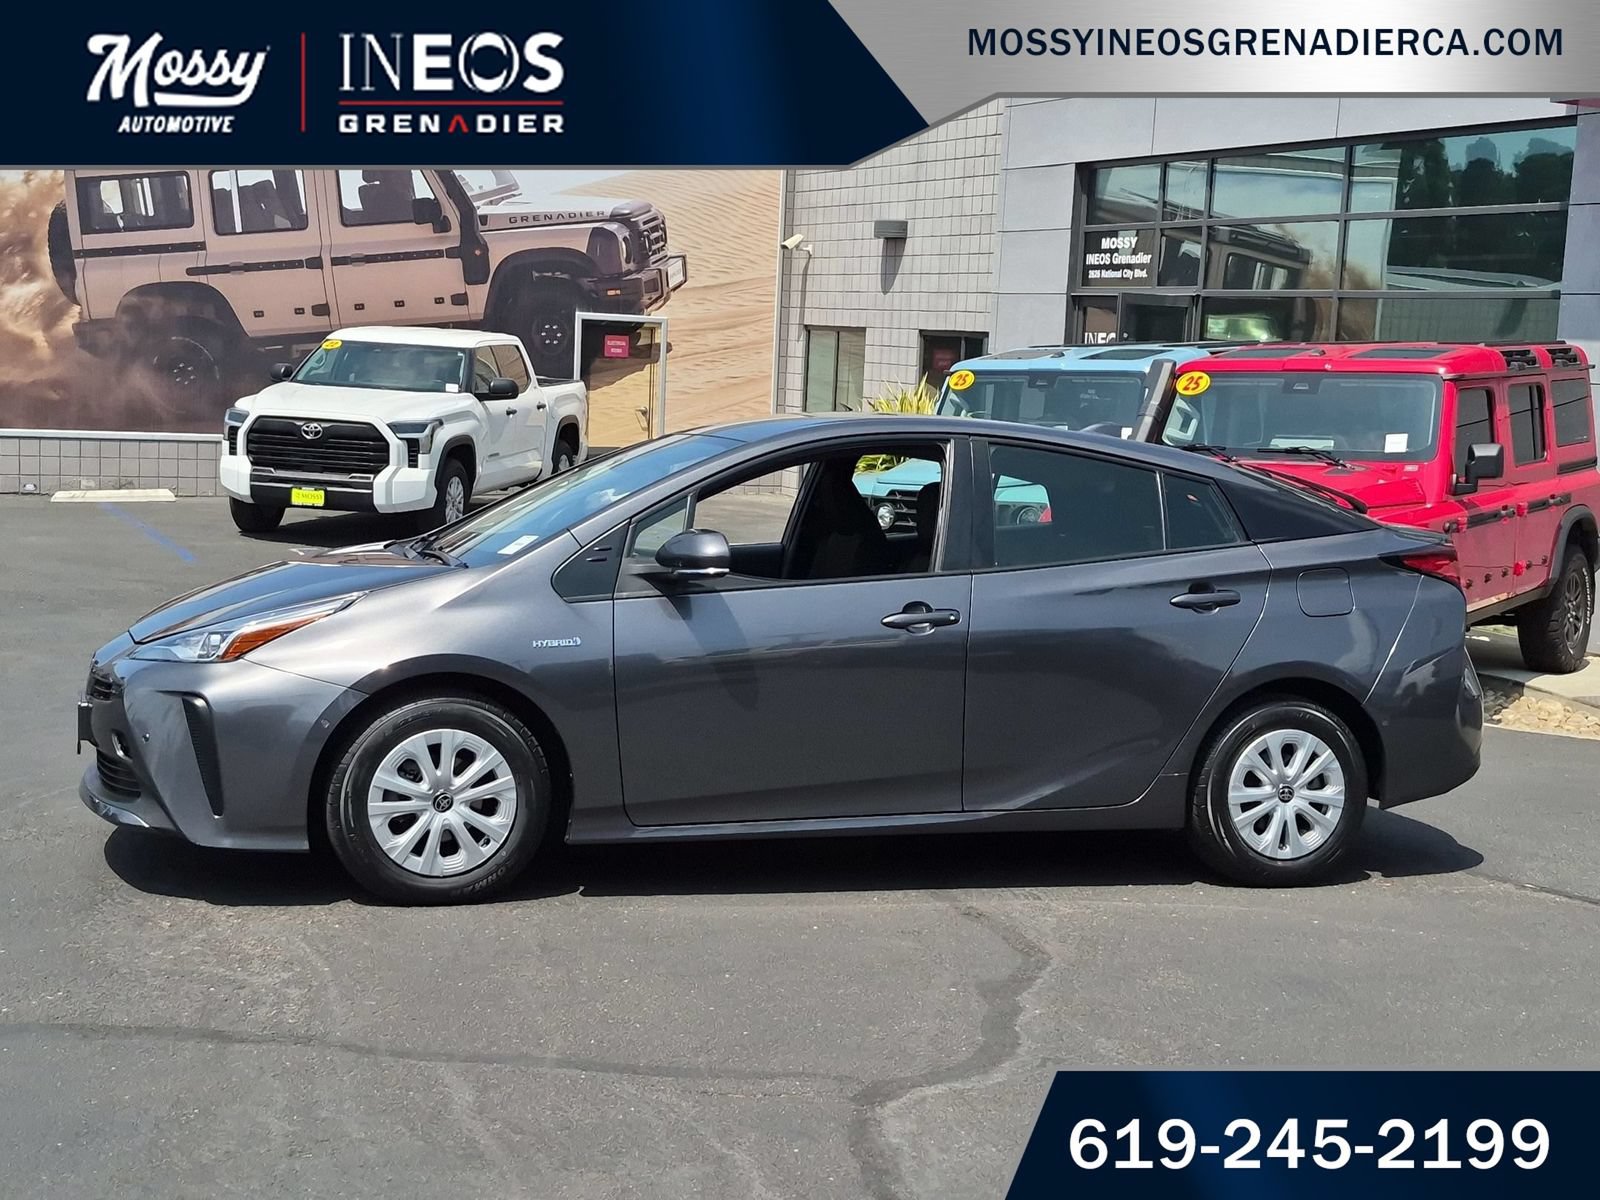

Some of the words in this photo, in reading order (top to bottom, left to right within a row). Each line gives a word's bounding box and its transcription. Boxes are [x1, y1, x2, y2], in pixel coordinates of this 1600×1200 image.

[509, 211, 605, 224] GRENADIER
[1101, 236, 1138, 250] MOSSY
[1086, 253, 1111, 265] INEOS
[1112, 252, 1152, 265] Grenadier
[1101, 269, 1122, 278] National
[1122, 268, 1133, 280] City
[953, 373, 970, 387] 25
[1183, 376, 1204, 391] 25
[532, 639, 574, 648] HYBRID
